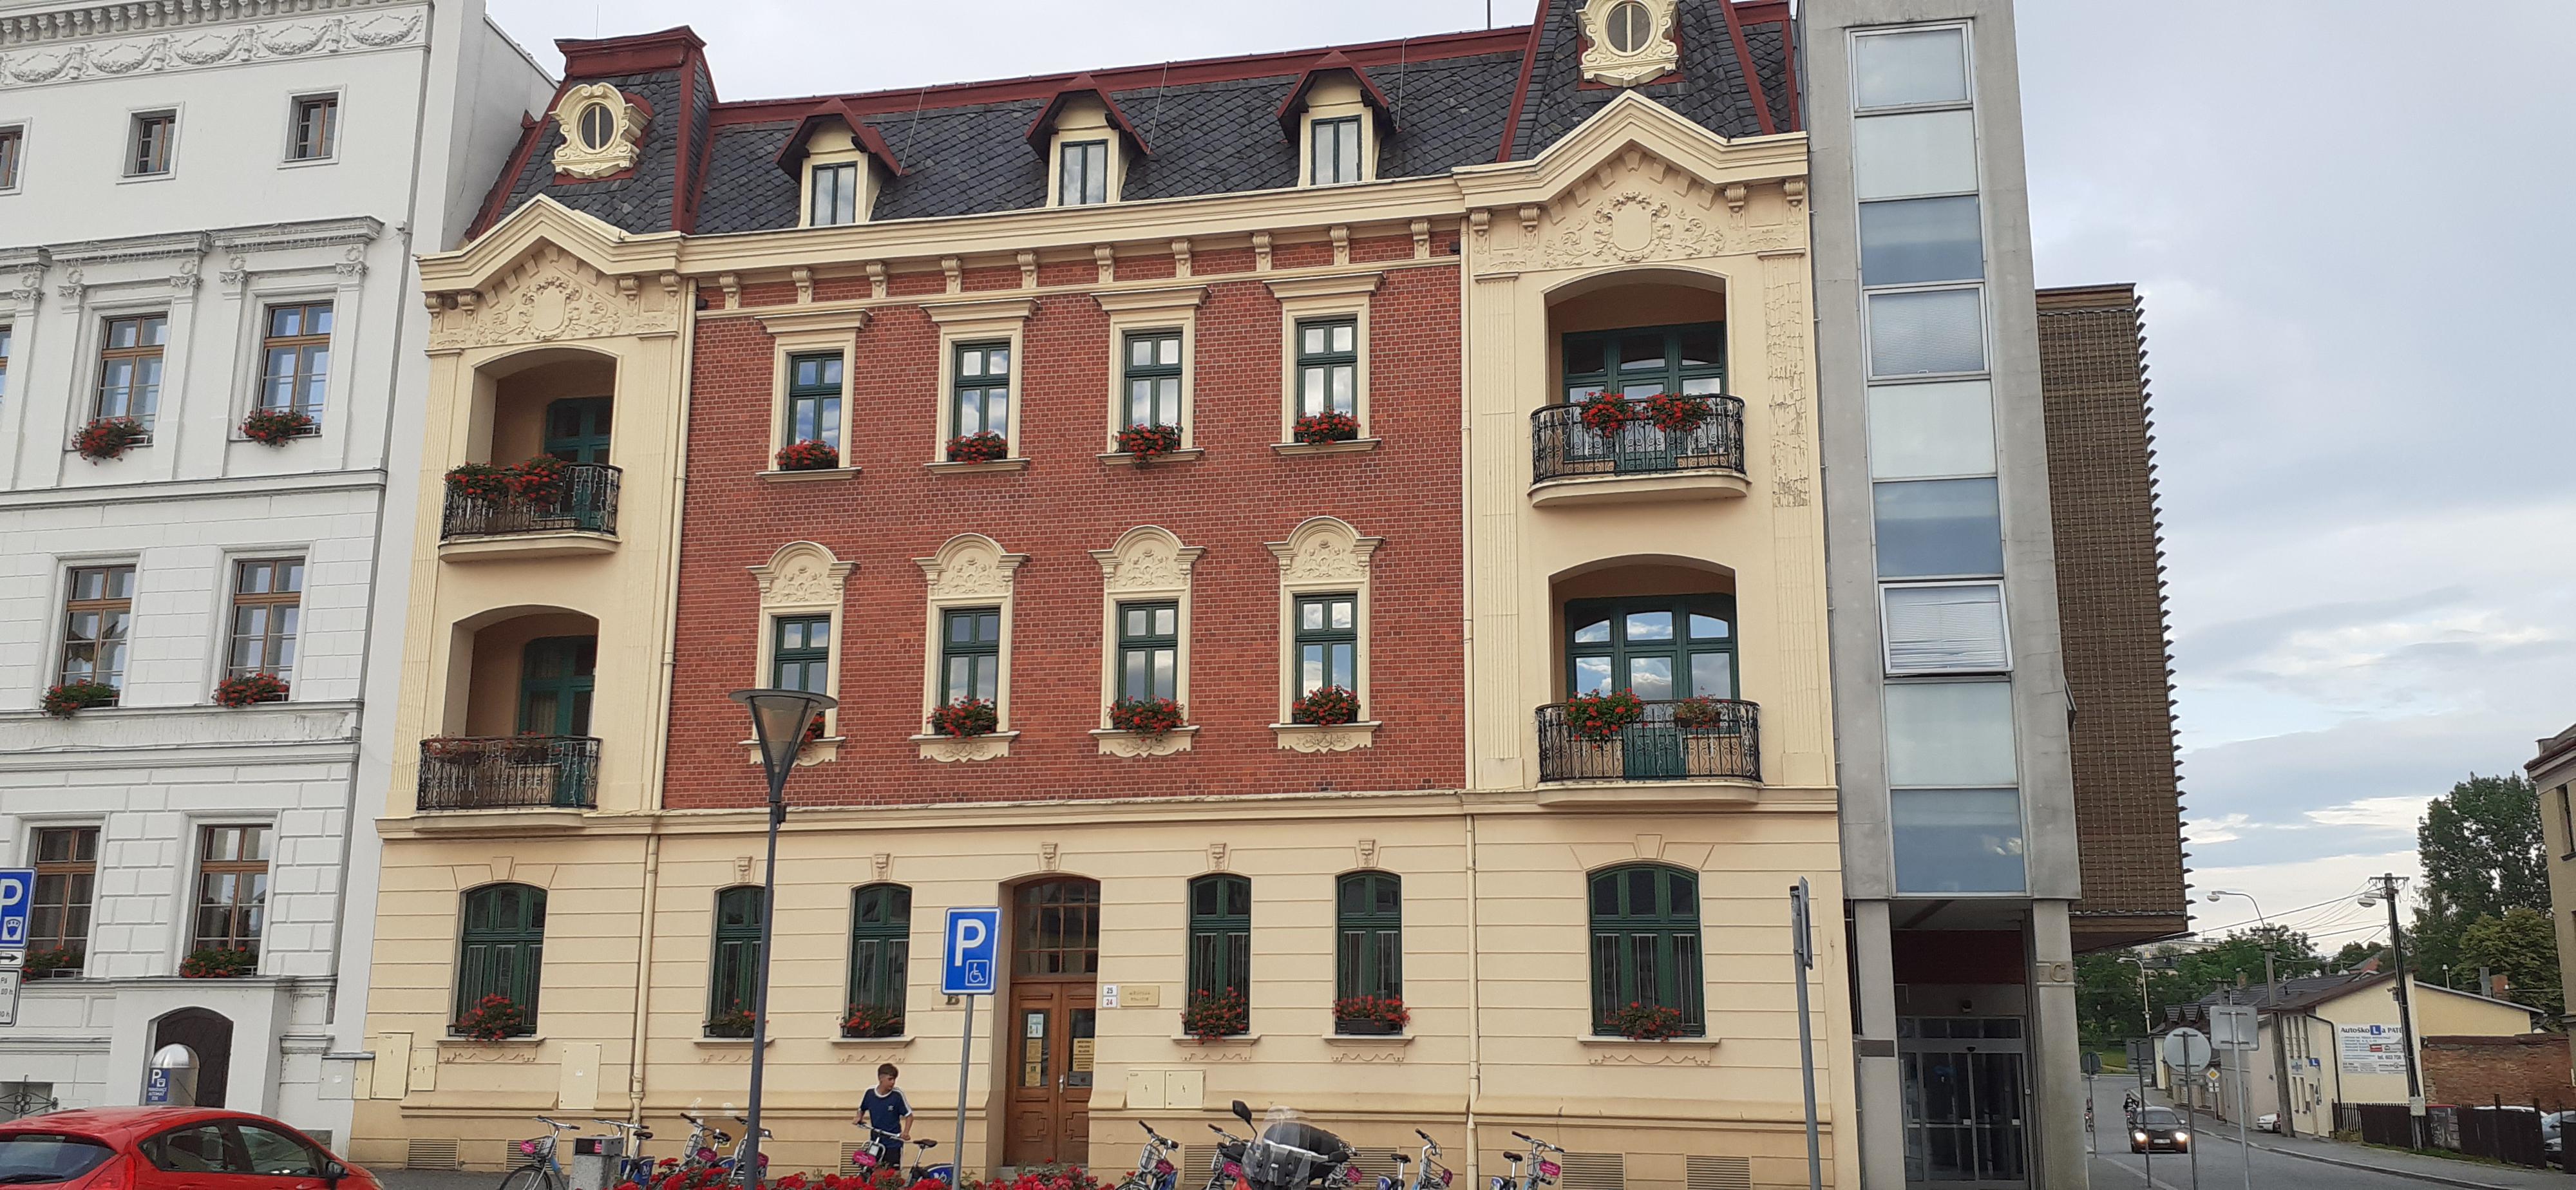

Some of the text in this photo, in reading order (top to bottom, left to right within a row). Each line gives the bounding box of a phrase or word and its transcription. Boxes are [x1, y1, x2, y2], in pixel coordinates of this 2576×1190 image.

[0, 878, 23, 921] P
[954, 919, 987, 967] P
[2050, 963, 2067, 983] C
[151, 1069, 162, 1084] P
